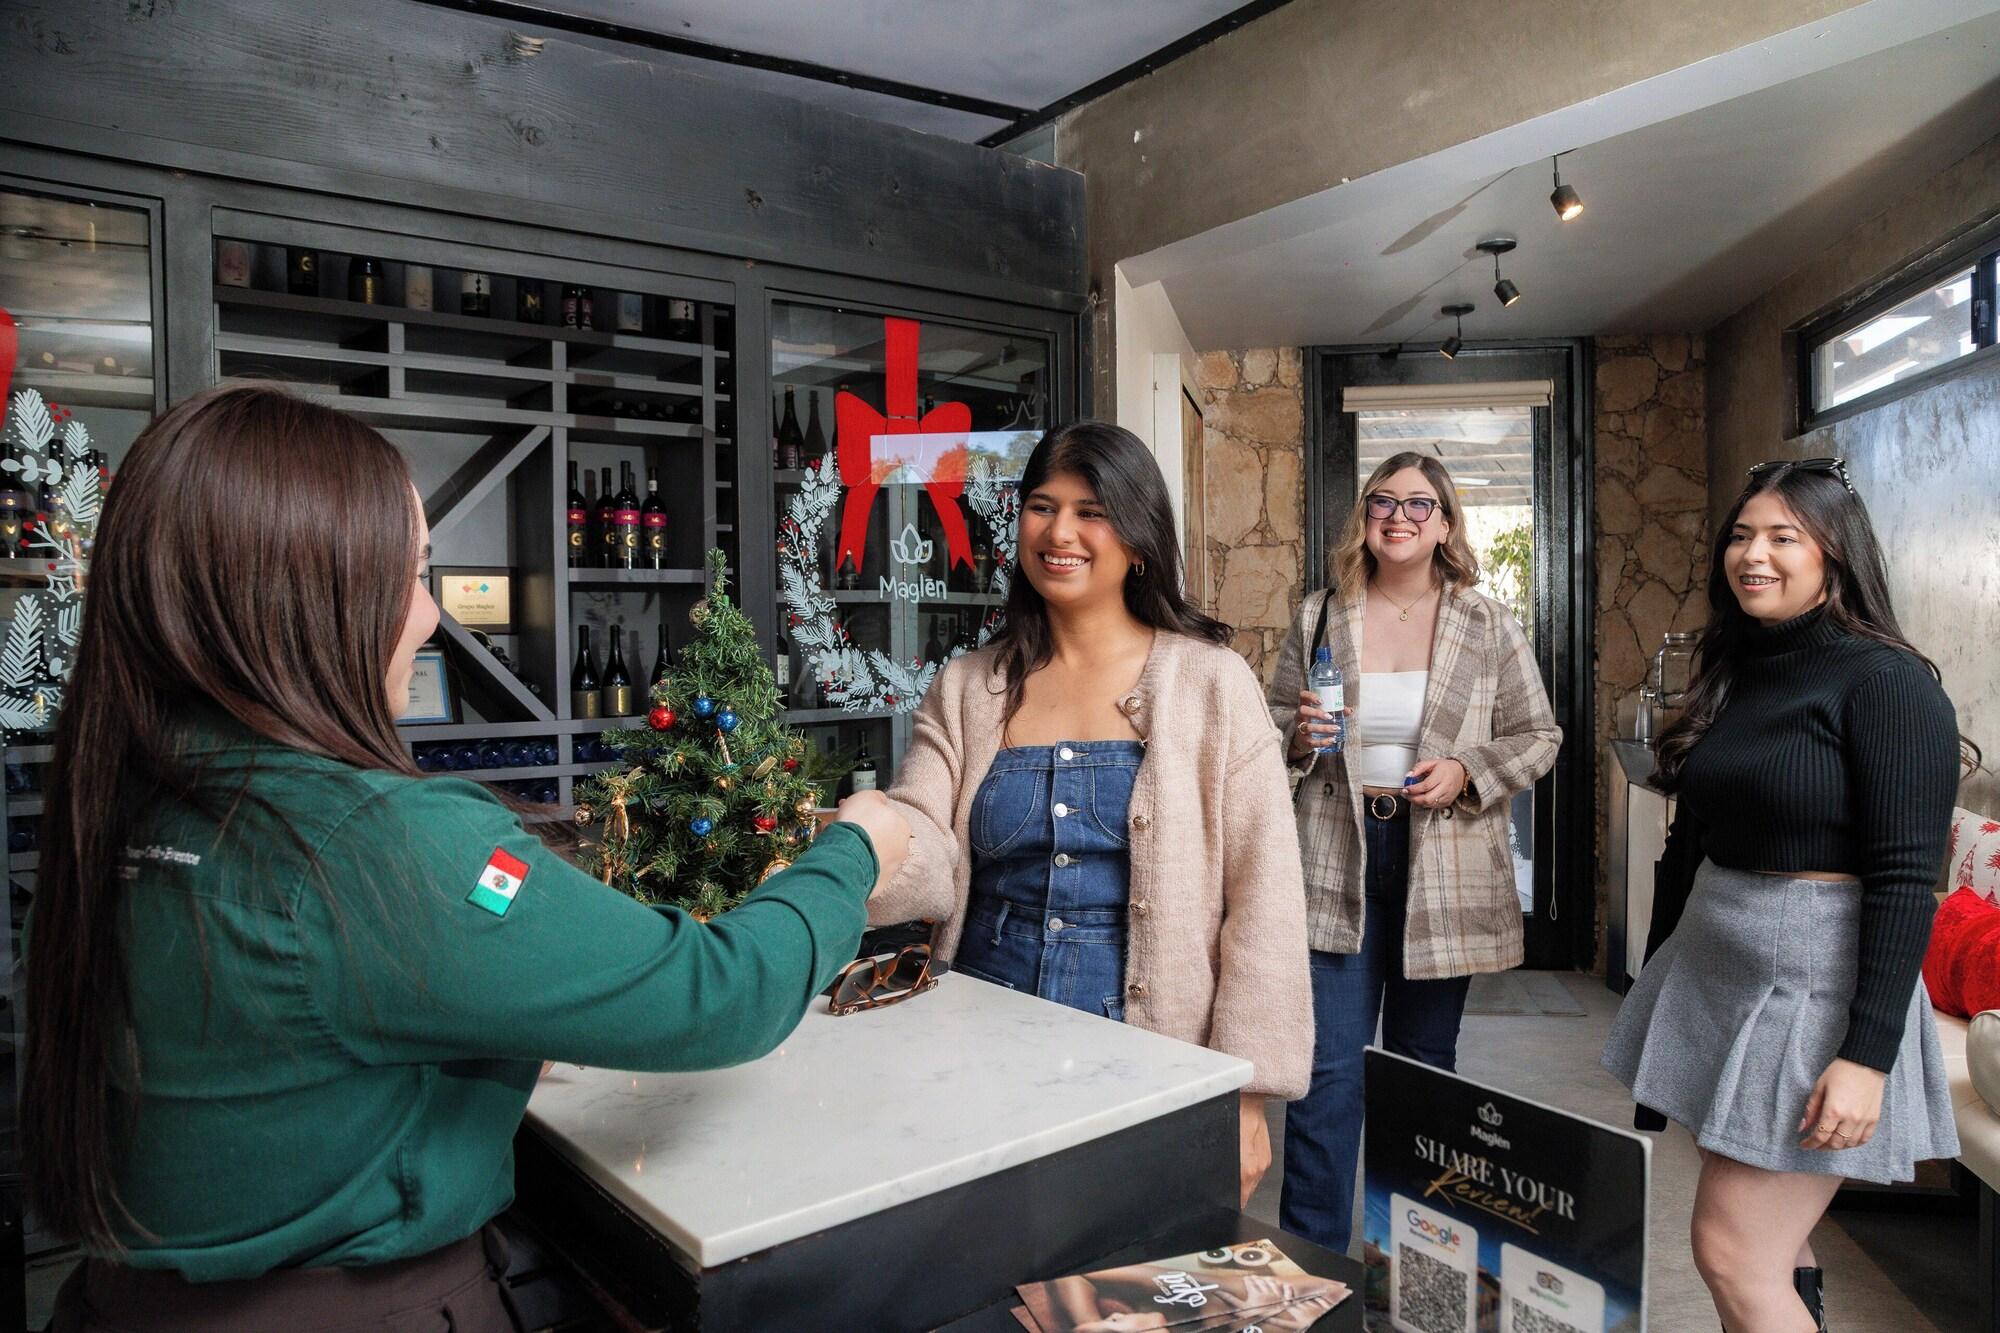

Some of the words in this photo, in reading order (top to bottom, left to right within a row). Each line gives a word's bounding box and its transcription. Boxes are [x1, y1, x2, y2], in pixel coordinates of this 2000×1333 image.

[879, 574, 947, 604] Maglēn
[1415, 1134, 1494, 1187] SHARE
[1501, 1167, 1576, 1220] YOUR
[1407, 1209, 1462, 1247] Google
